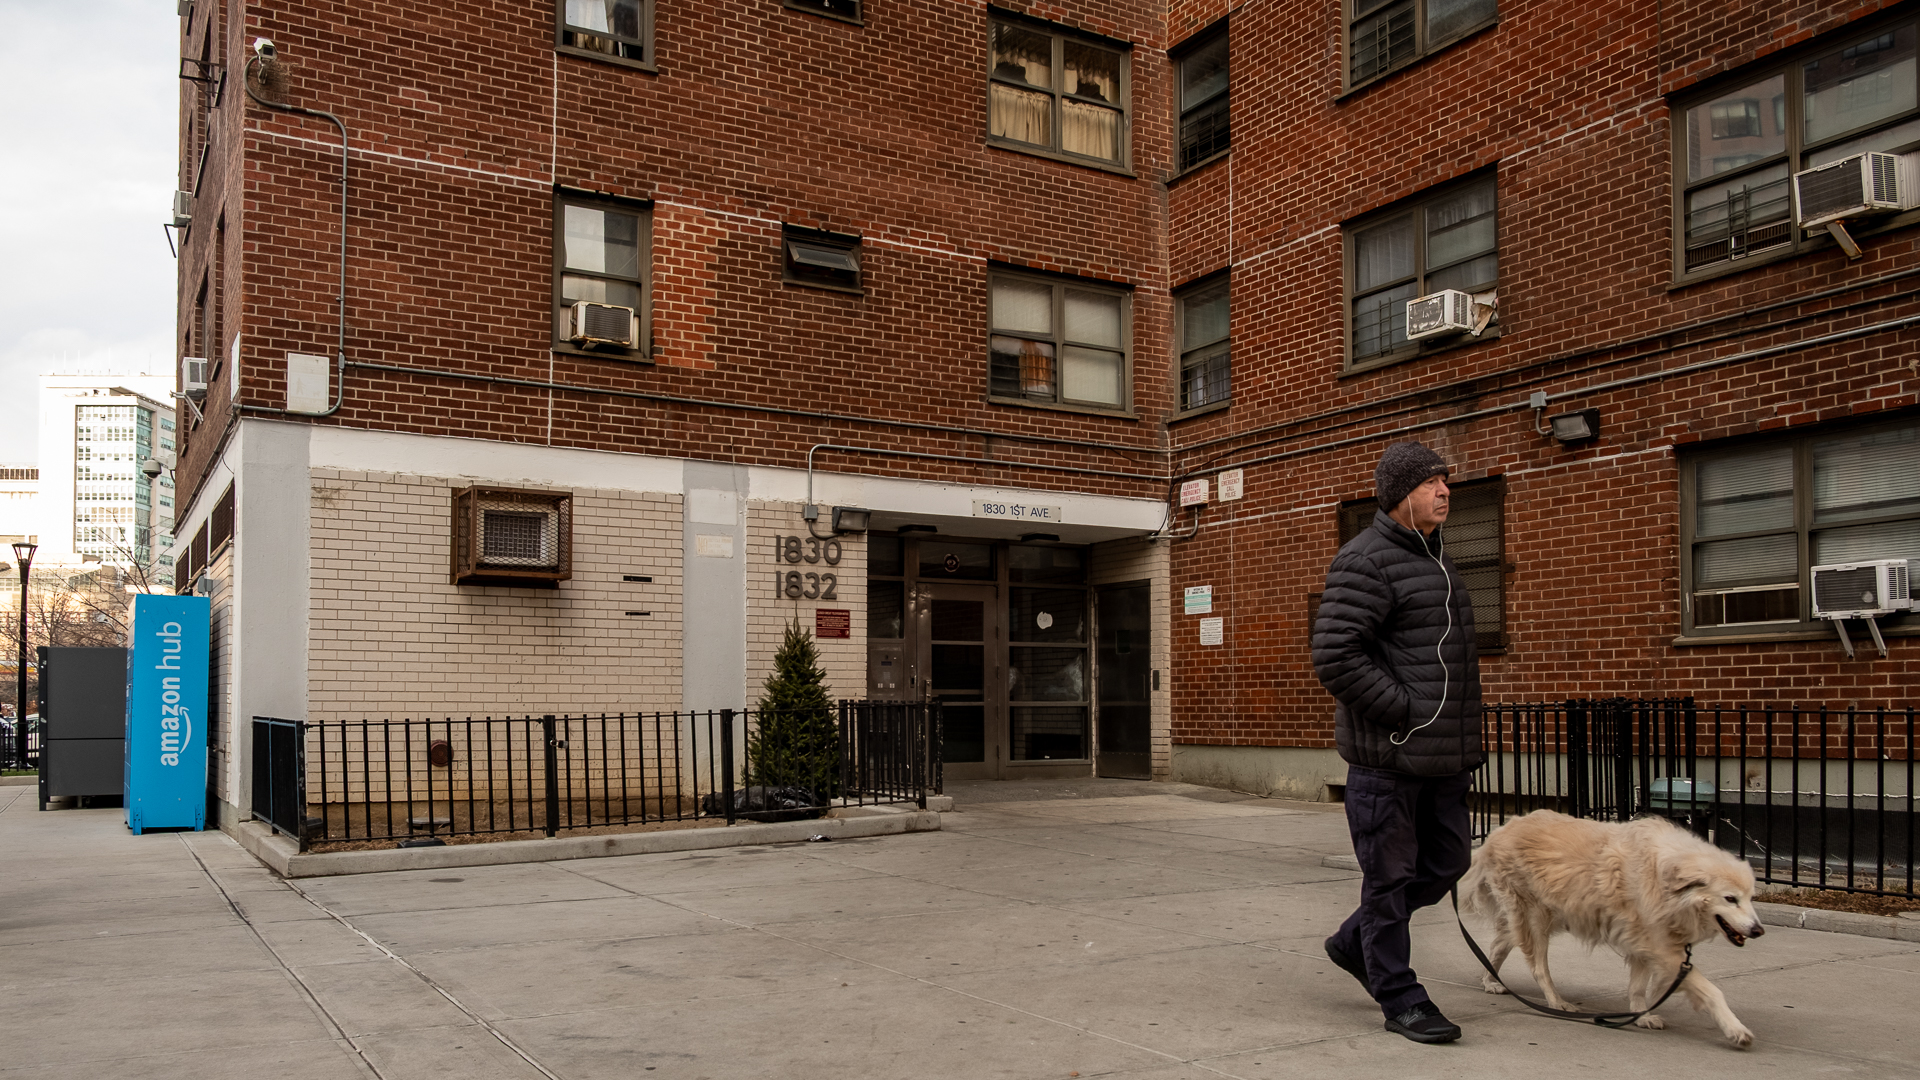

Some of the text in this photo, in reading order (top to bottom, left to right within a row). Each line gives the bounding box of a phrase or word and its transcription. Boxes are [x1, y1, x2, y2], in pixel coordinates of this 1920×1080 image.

[1221, 478, 1240, 486] EMERGENCY
[1222, 472, 1239, 480] ELEVATOR
[1181, 488, 1201, 497] EMERGENCY
[982, 503, 1006, 515] 1830
[1009, 505, 1027, 516] 1ST
[775, 535, 842, 565] 1830
[776, 570, 838, 600] 1832
[155, 621, 182, 767] amazon hub
